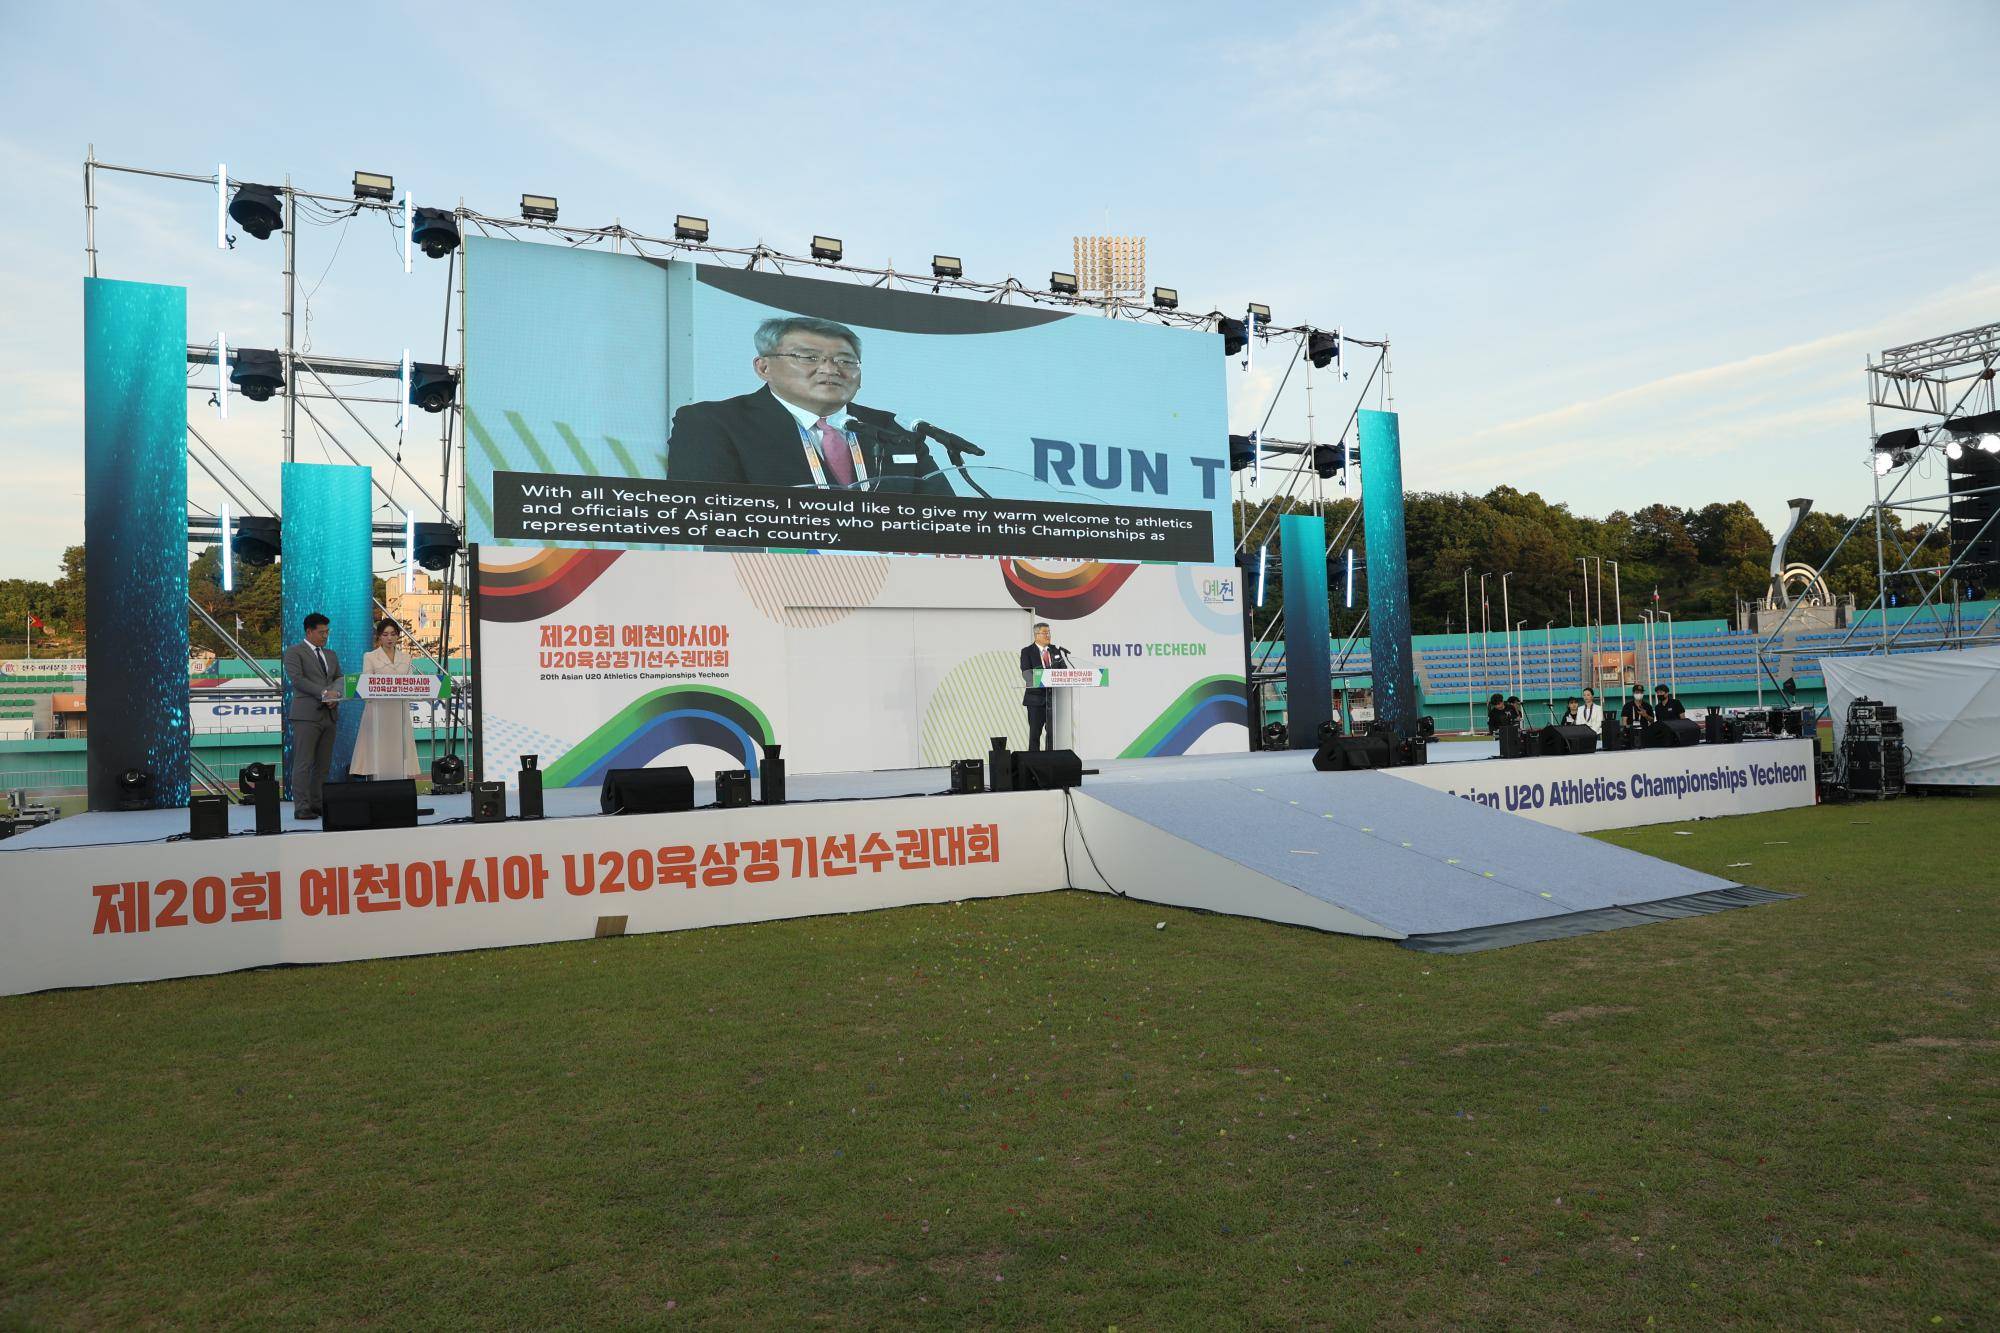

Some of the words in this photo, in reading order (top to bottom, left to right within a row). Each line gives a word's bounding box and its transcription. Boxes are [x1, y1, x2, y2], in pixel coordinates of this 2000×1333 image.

[1030, 437, 1168, 496] RUN
[521, 484, 572, 499] With
[581, 487, 604, 500] all
[612, 489, 697, 504] Yecheon
[704, 493, 779, 509] citizens,
[787, 498, 792, 509] I
[799, 500, 854, 513] would
[861, 502, 891, 514] like
[898, 504, 915, 516] to
[922, 505, 956, 519] give
[963, 509, 987, 521] my
[993, 510, 1037, 521] warm
[1043, 512, 1110, 526] welcome
[1115, 515, 1130, 526] to
[1135, 516, 1193, 529] athletics
[522, 503, 562, 515] and
[571, 504, 649, 518] officials
[657, 507, 678, 520] of
[684, 508, 737, 522] Asian
[745, 512, 831, 527] countries
[836, 516, 874, 529] who
[881, 518, 971, 534] participate
[977, 522, 991, 533] in
[998, 523, 1026, 535] this
[1032, 524, 1146, 542] Championships
[1150, 532, 1166, 541] as
[522, 520, 680, 536] representatives
[688, 525, 708, 536] of
[715, 526, 760, 539] each
[767, 529, 842, 544] country.
[540, 625, 615, 648] 제20회
[621, 625, 730, 648] 예천아시아
[540, 650, 730, 669] U20육상경기선수권대회
[1092, 643, 1121, 657] RUN
[1125, 643, 1143, 656] TO
[1146, 643, 1207, 656] YECHEON
[368, 677, 393, 686] 제20회
[394, 677, 430, 686] 예천아시아
[639, 672, 697, 680] Championships
[1505, 783, 1545, 812] U20
[1549, 776, 1627, 807] Athletics
[1630, 765, 1748, 800] Championships
[1749, 762, 1807, 786] Yecheon
[92, 871, 282, 935] 제20회
[300, 853, 549, 917] 예천아시아
[562, 824, 1000, 897] U20육상경기선수권대회
